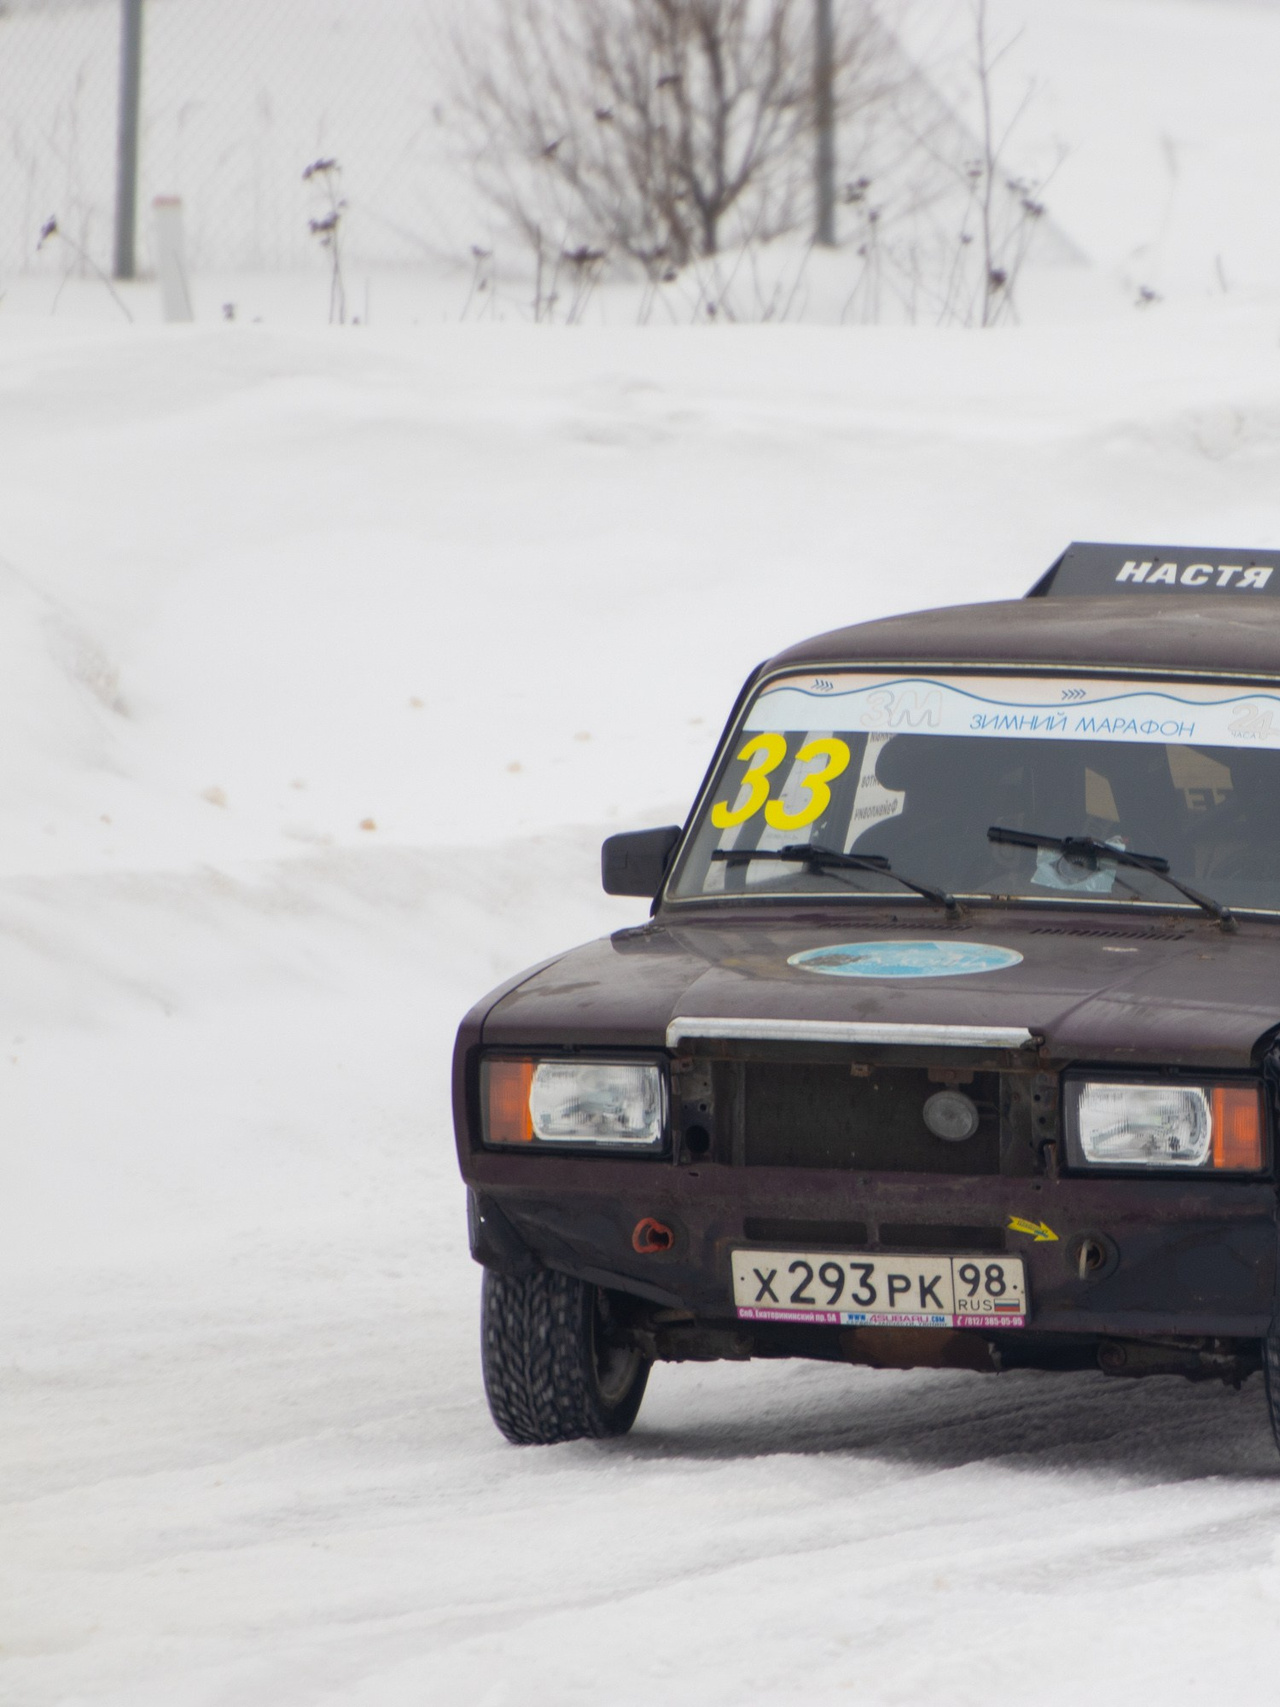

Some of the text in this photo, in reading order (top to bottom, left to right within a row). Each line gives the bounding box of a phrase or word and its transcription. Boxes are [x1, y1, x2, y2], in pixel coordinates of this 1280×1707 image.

[1115, 561, 1274, 589] НАСТЯ
[969, 711, 1196, 738] ЗИМНИЙ МАРАФОН
[711, 732, 851, 831] 33
[958, 1263, 1007, 1297] 98
[958, 1299, 993, 1312] RUS
